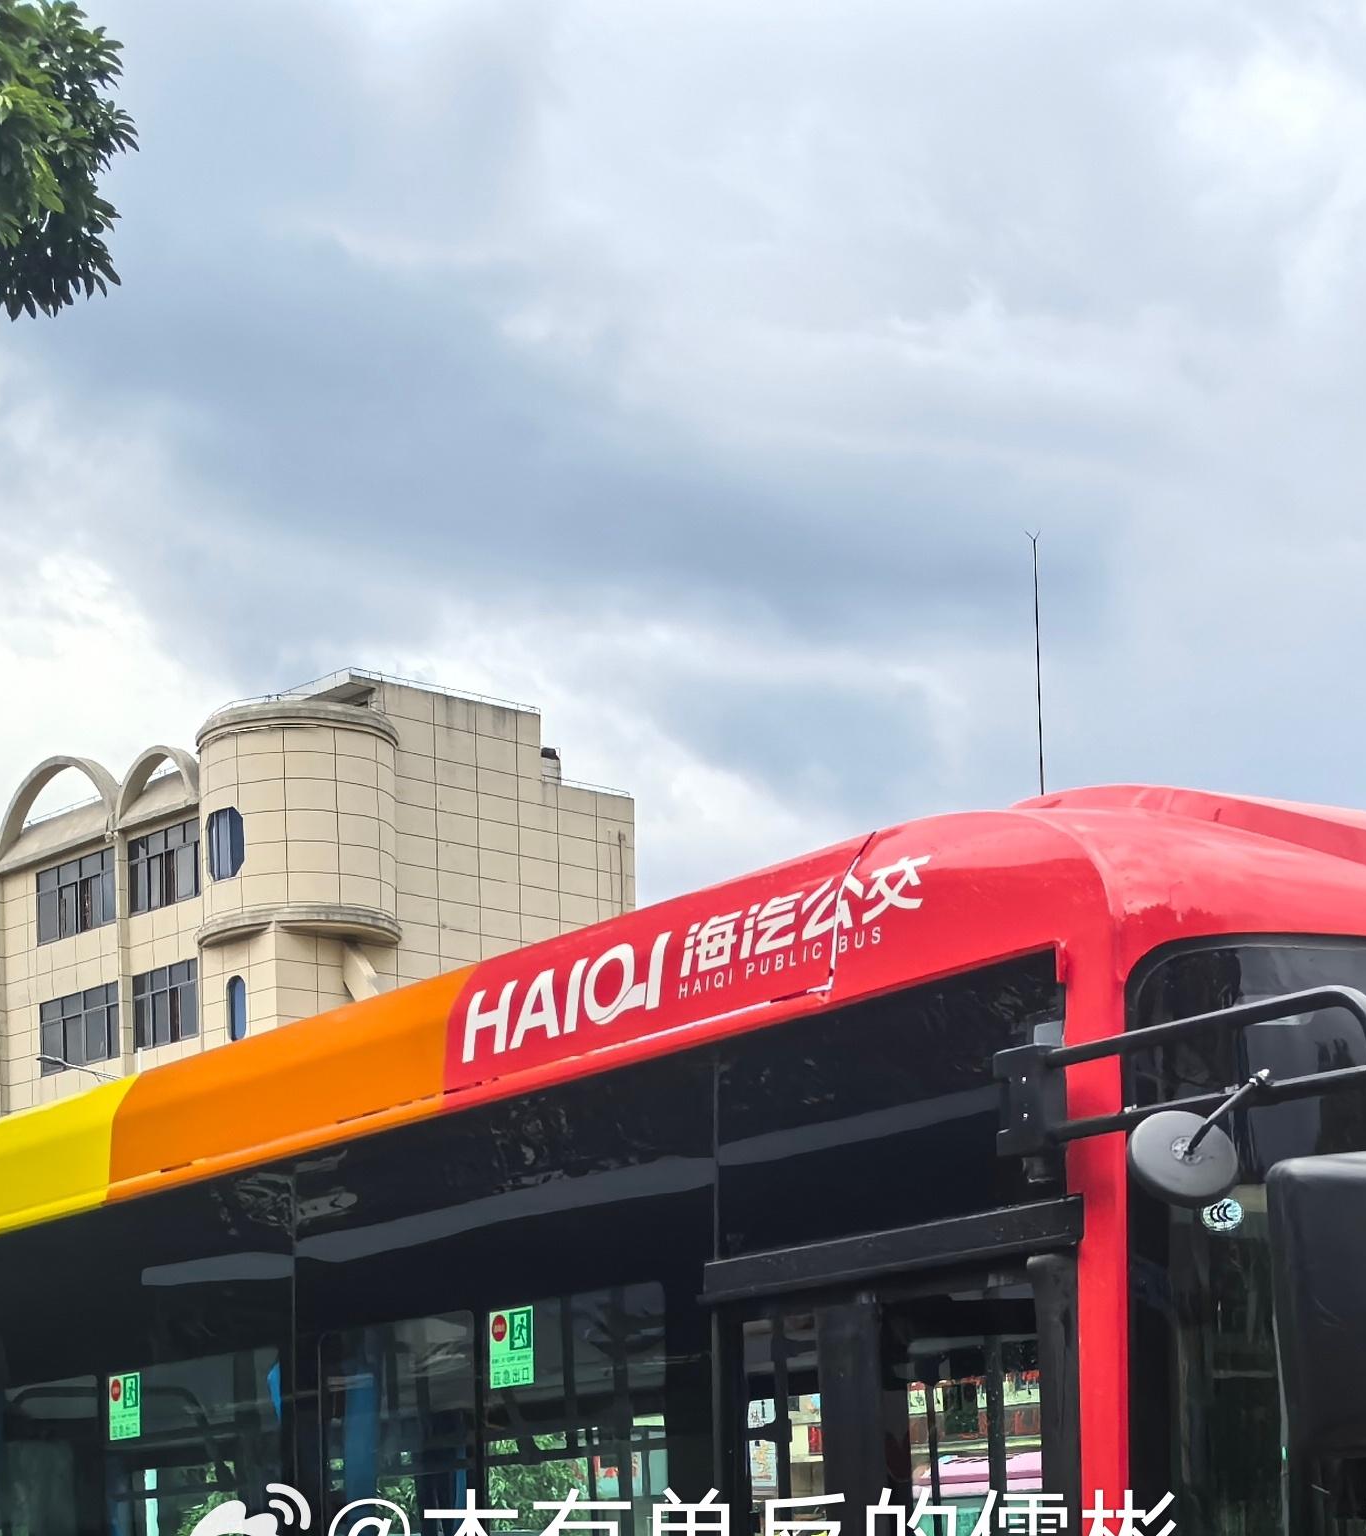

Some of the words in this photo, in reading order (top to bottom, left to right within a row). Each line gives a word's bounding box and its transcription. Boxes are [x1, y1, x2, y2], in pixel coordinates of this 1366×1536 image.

[678, 971, 733, 1000] HAIQI
[745, 942, 823, 979] PUBLIC
[838, 926, 882, 954] BUS
[679, 855, 930, 978] 海汽公交
[462, 931, 671, 1063] HAIQI
